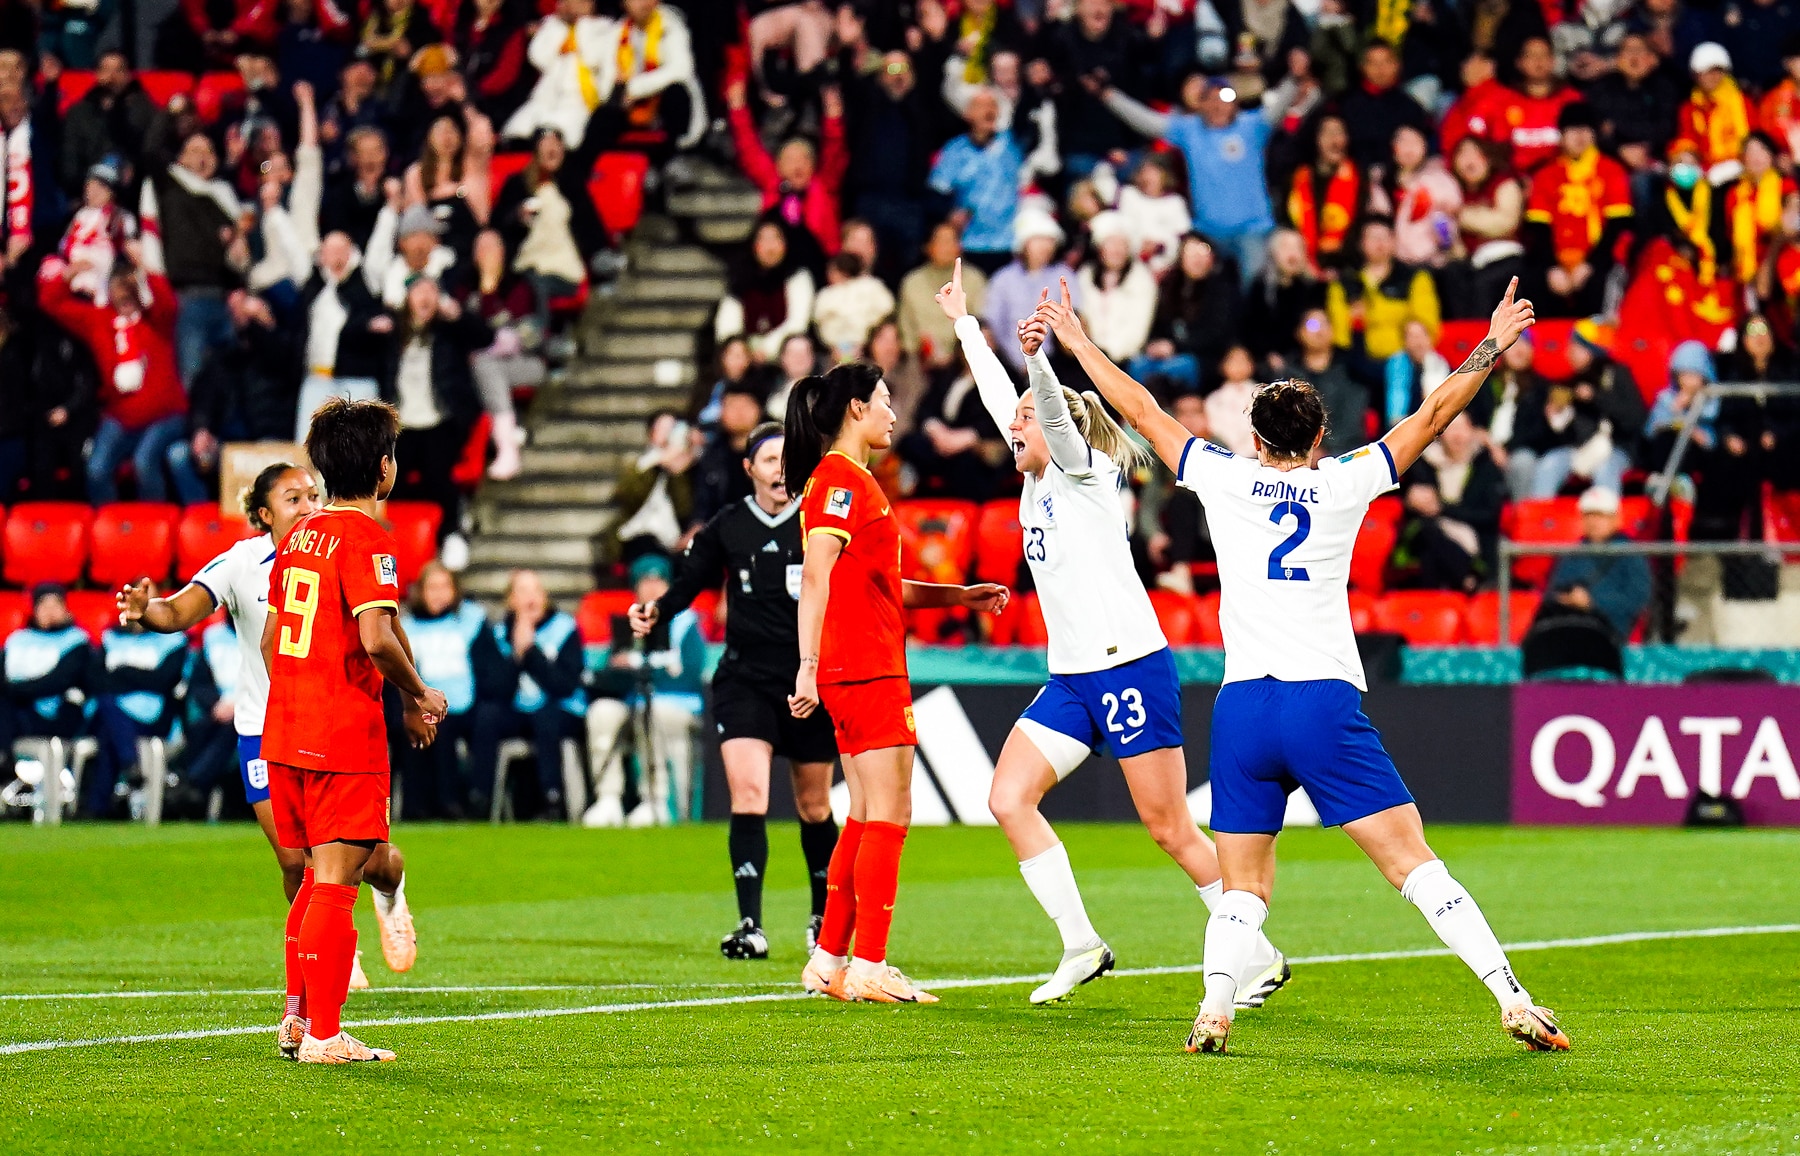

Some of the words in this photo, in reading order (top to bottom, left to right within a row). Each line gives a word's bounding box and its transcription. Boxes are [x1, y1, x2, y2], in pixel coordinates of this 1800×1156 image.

[1267, 501, 1311, 581] 2
[1101, 687, 1147, 733] 23
[1530, 714, 1800, 807] QATA
